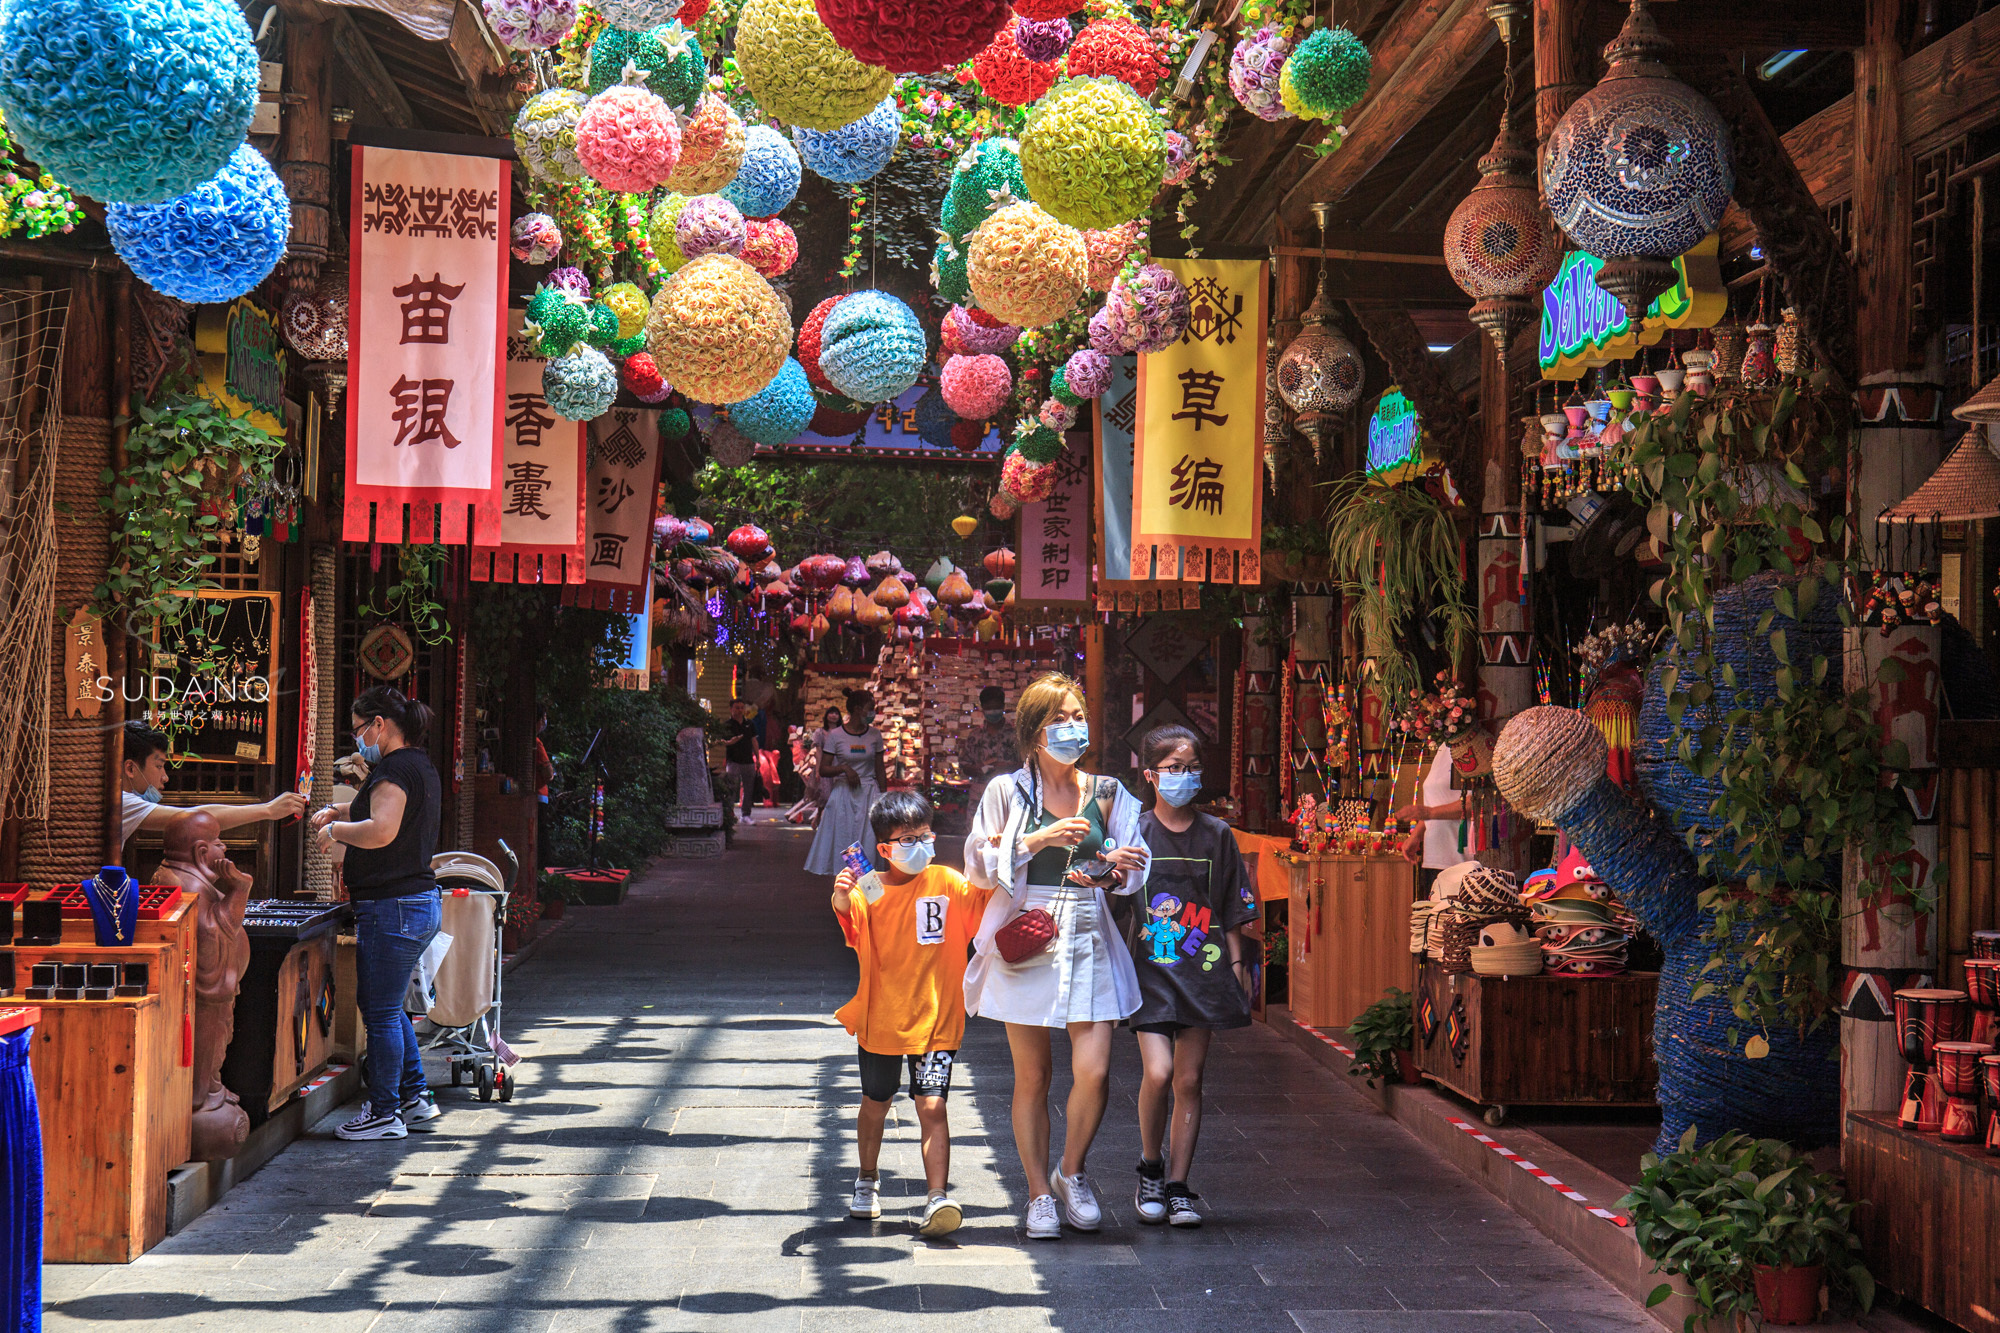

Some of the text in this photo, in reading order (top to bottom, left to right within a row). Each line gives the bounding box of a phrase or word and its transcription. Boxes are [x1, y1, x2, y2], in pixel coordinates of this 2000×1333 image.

[389, 272, 466, 449] 苗银
[503, 393, 555, 520] 香囊
[1169, 367, 1229, 516] 草编
[590, 477, 634, 570] 沙画
[1041, 491, 1071, 590] 世家制印
[74, 625, 98, 700] 景泰蓝
[924, 901, 943, 933] B
